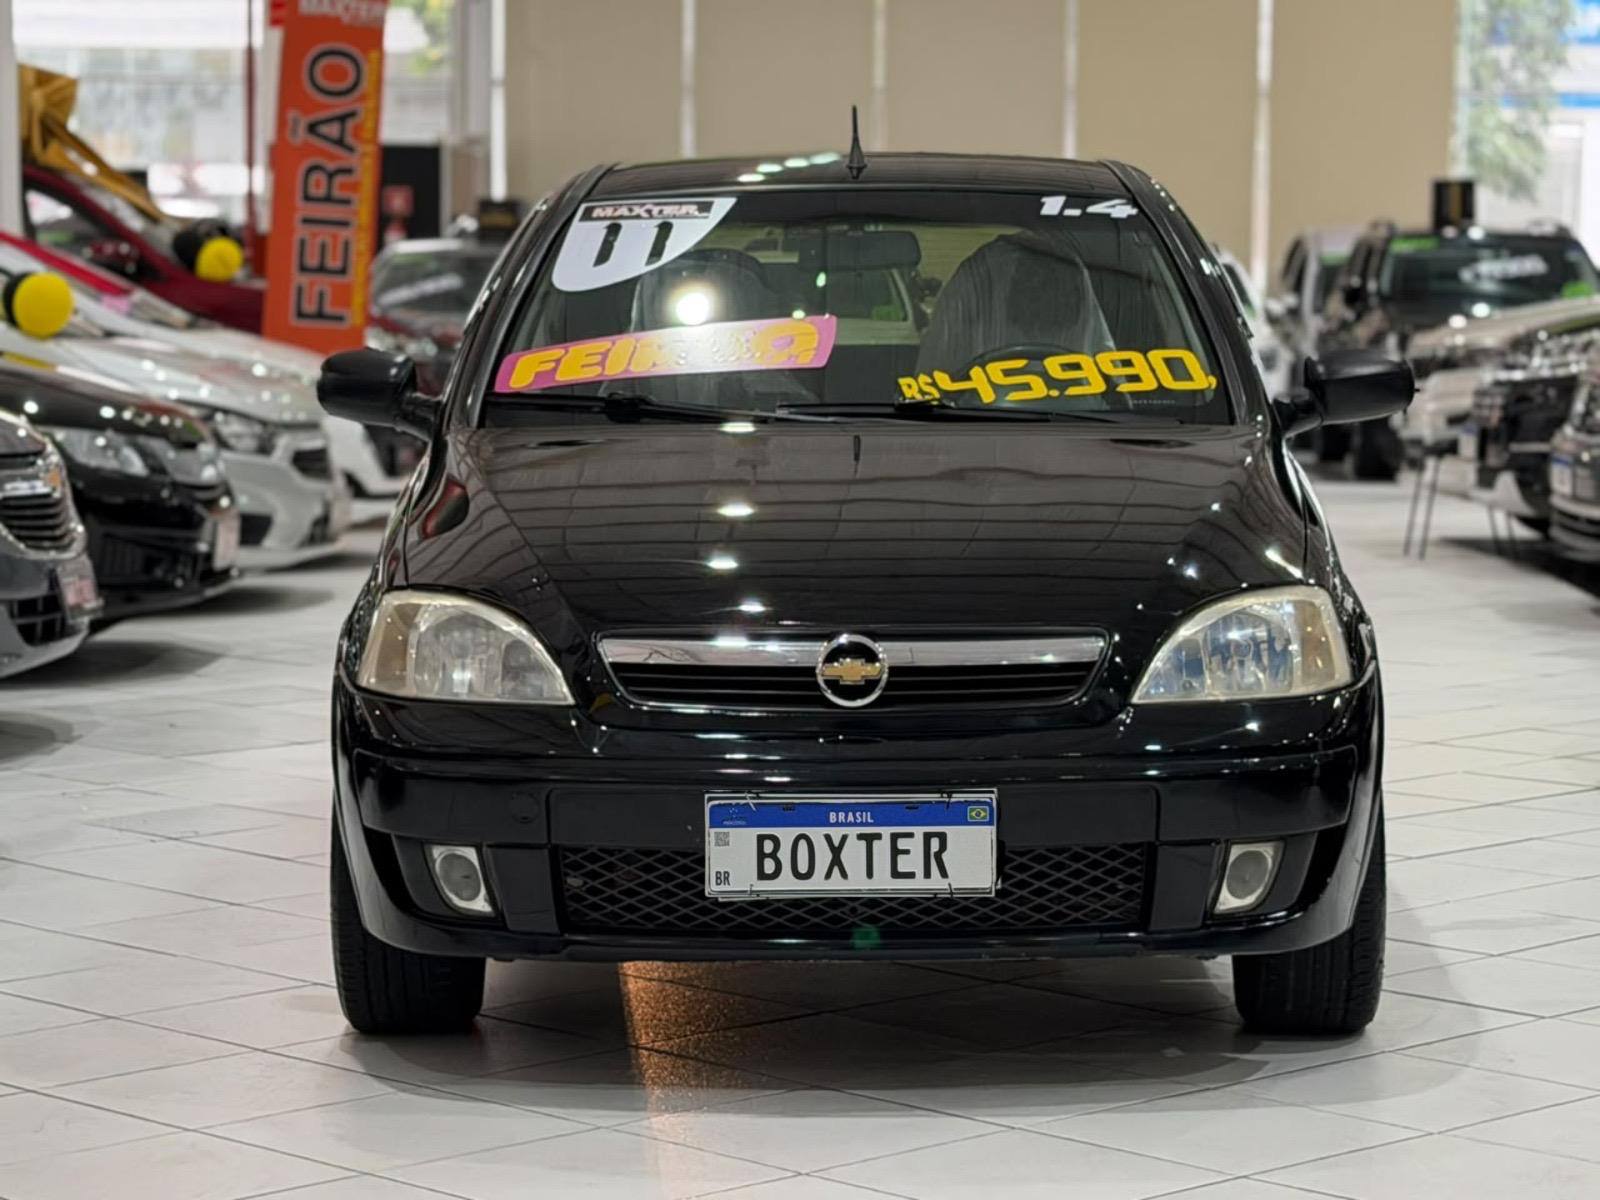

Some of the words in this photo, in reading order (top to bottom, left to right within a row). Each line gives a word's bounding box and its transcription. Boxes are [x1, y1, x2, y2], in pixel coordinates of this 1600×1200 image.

[287, 42, 368, 327] FEIRÃO
[1040, 195, 1138, 218] 1.4
[593, 220, 674, 267] 11
[829, 811, 874, 823] BRASIL
[757, 831, 949, 881] BOXTER
[715, 871, 730, 886] BR
